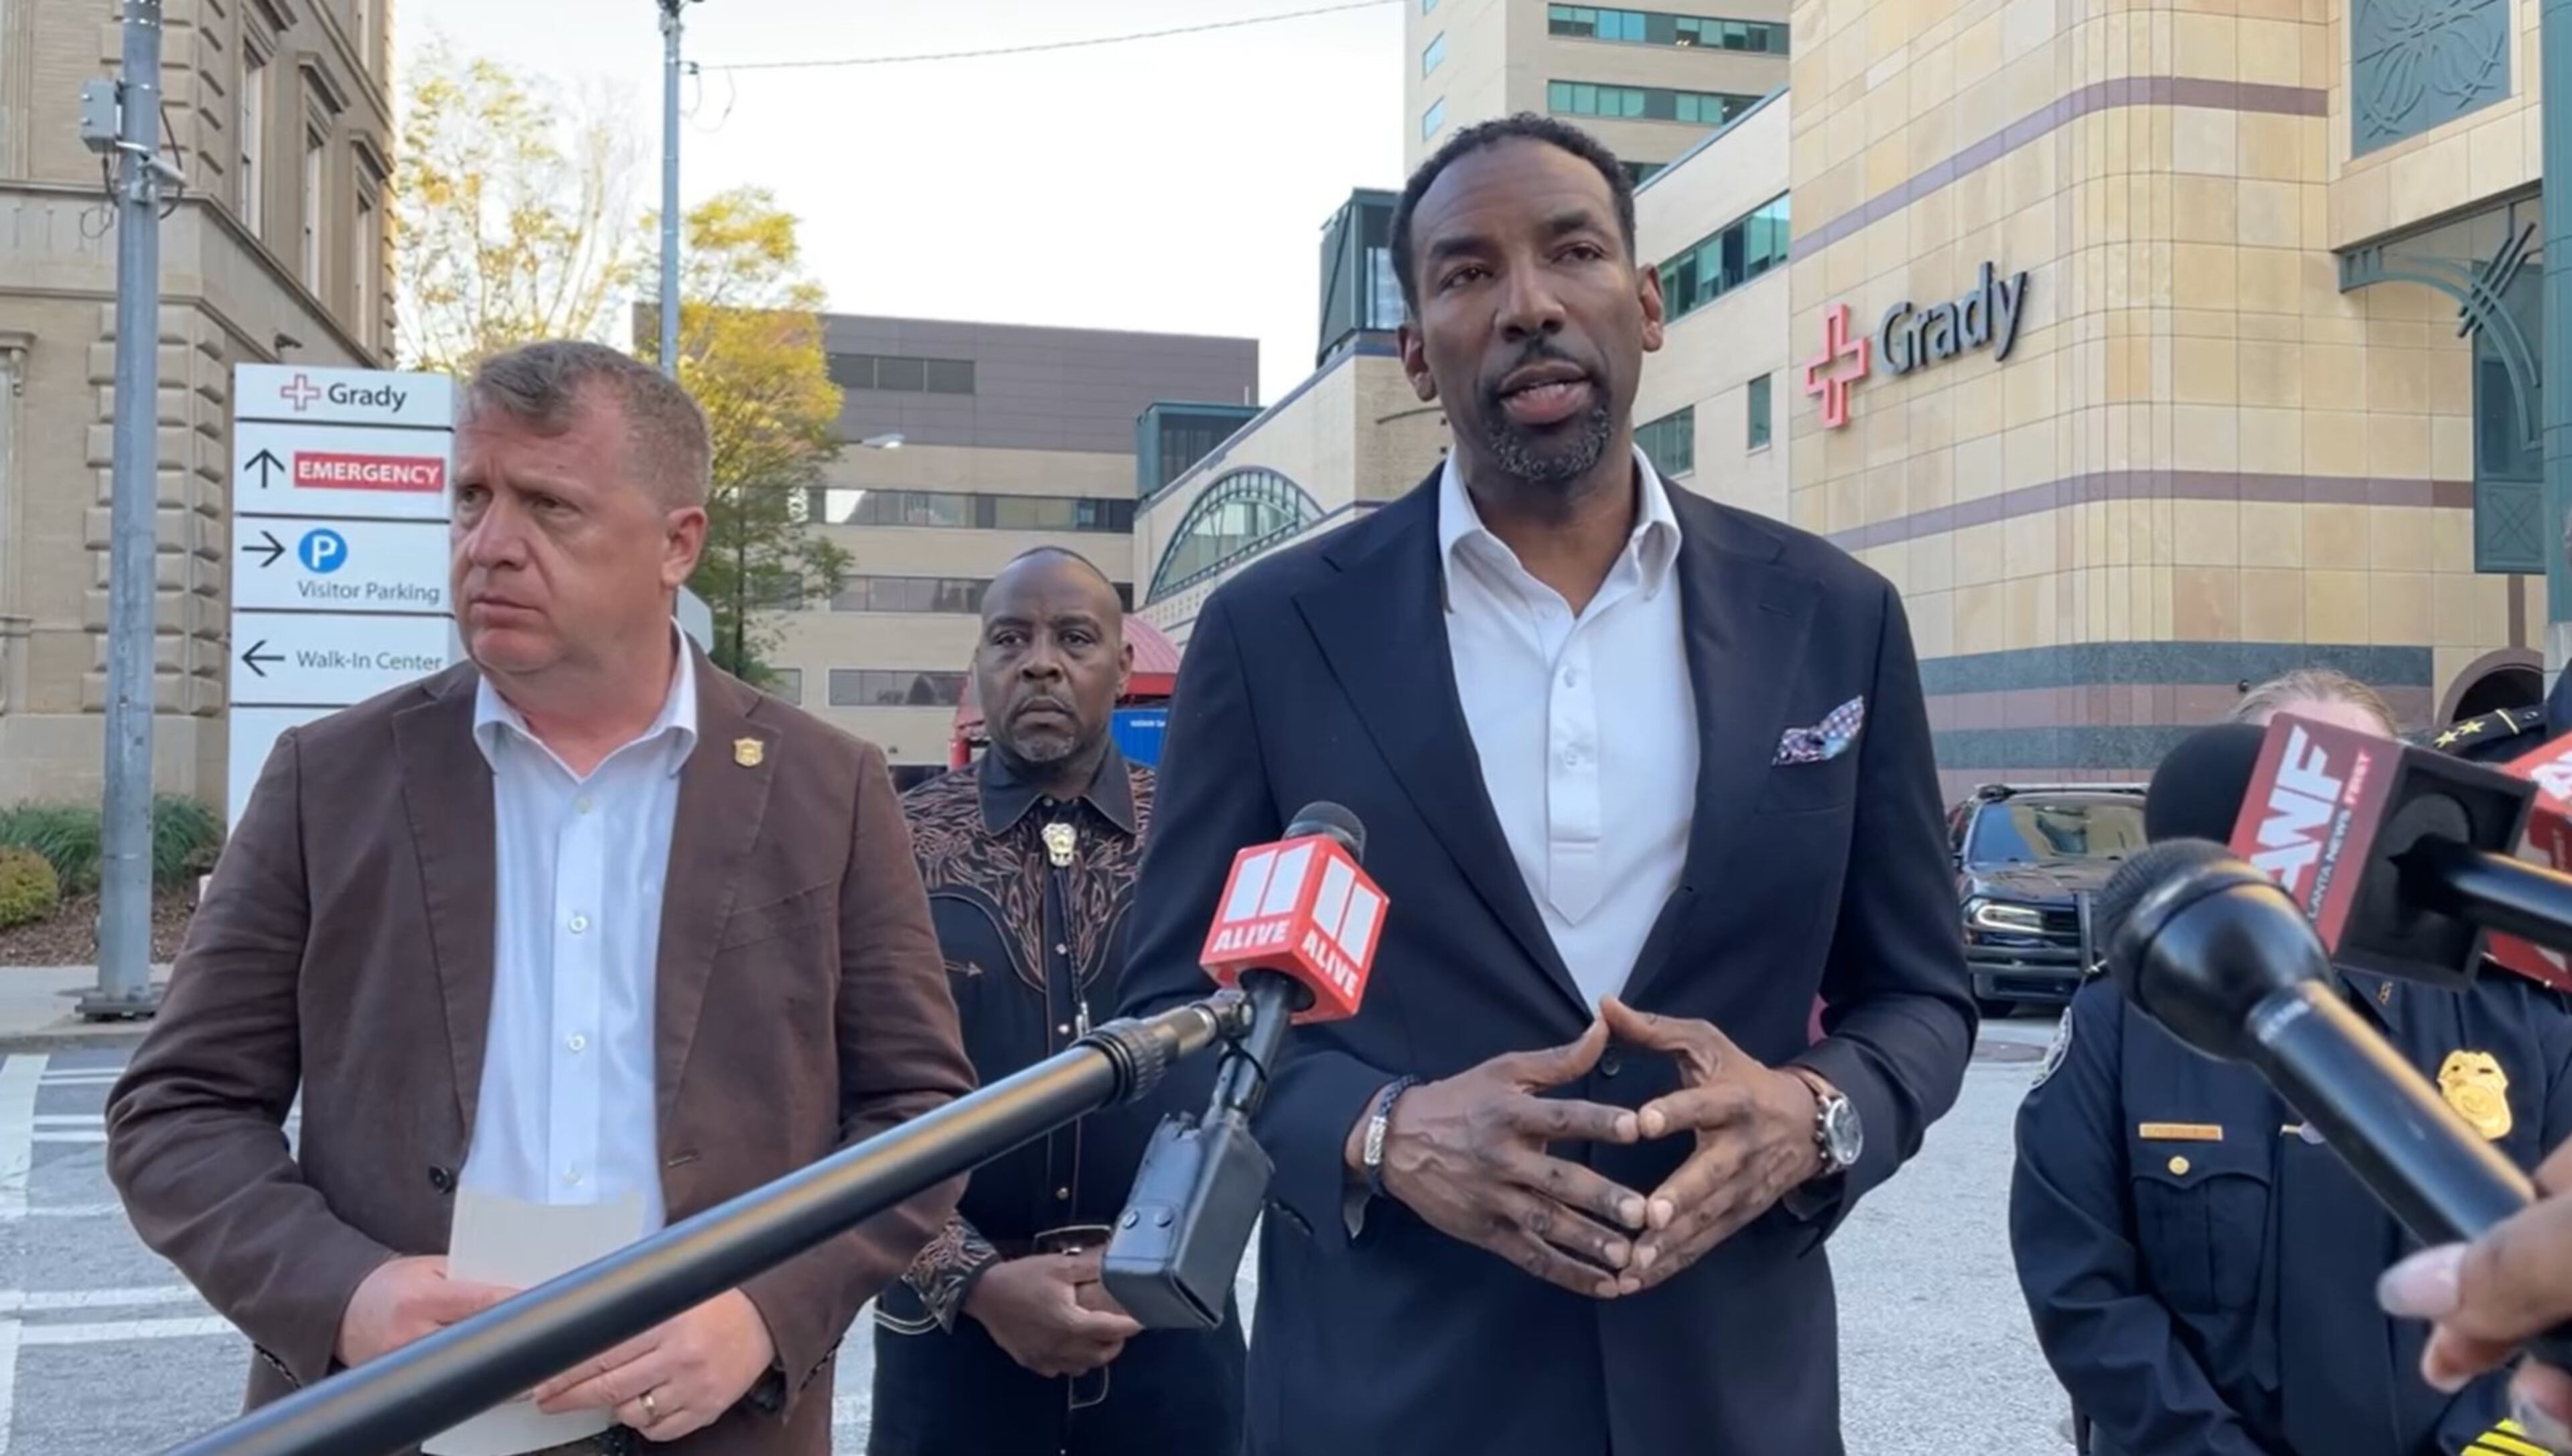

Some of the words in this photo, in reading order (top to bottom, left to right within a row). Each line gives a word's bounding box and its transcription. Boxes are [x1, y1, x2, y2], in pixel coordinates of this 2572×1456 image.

[1877, 261, 2027, 375] Grady
[328, 382, 407, 413] Grady
[297, 460, 440, 485] EMERGENCY
[311, 535, 338, 569] P
[297, 580, 360, 599] Visitor
[366, 582, 441, 605] Parking
[296, 650, 371, 669] Walk-In
[376, 652, 443, 671] Center
[2250, 724, 2343, 894] ANF
[2307, 865, 2334, 919] LANTA
[2343, 748, 2372, 806] FIRST
[1211, 920, 1291, 953] ALIVE
[1301, 929, 1359, 998] ALIVE
